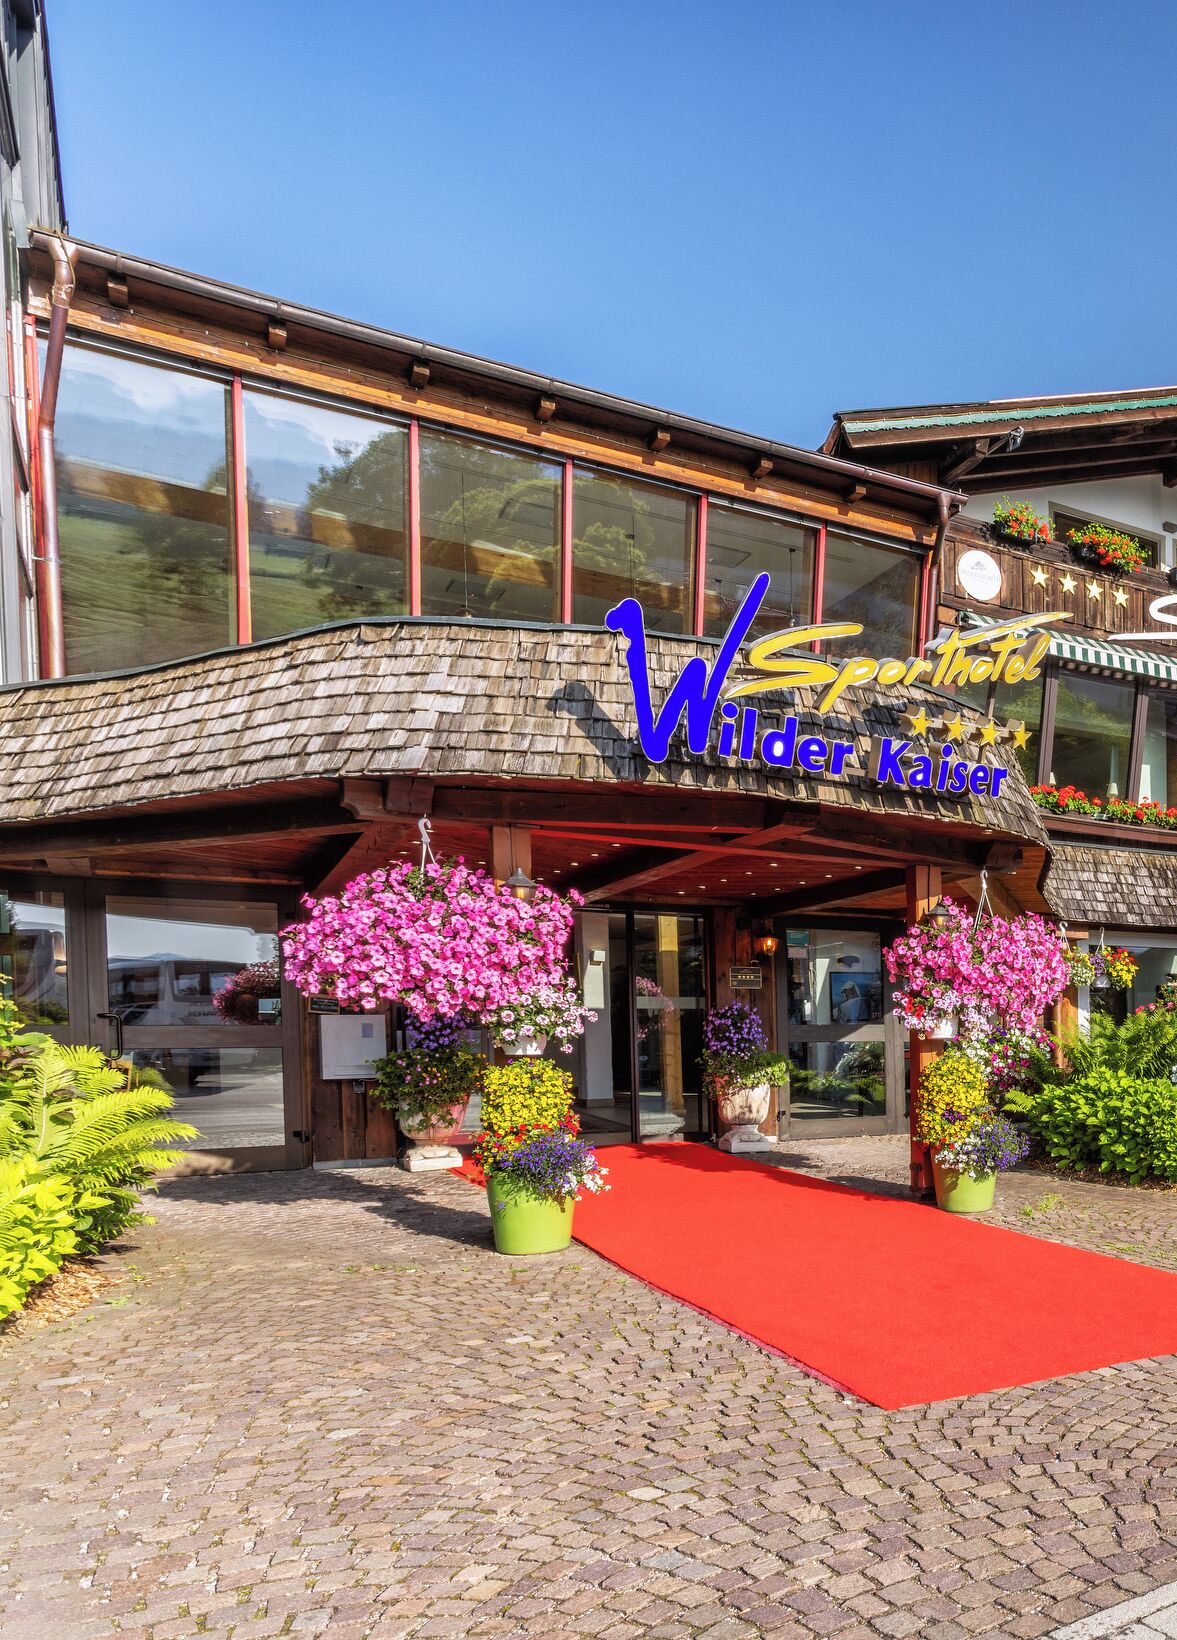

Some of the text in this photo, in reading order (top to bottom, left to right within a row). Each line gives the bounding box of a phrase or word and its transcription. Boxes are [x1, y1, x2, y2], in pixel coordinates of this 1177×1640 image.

[604, 571, 1009, 799] Wilder Kaiser
[721, 611, 1074, 714] Sporthotel
